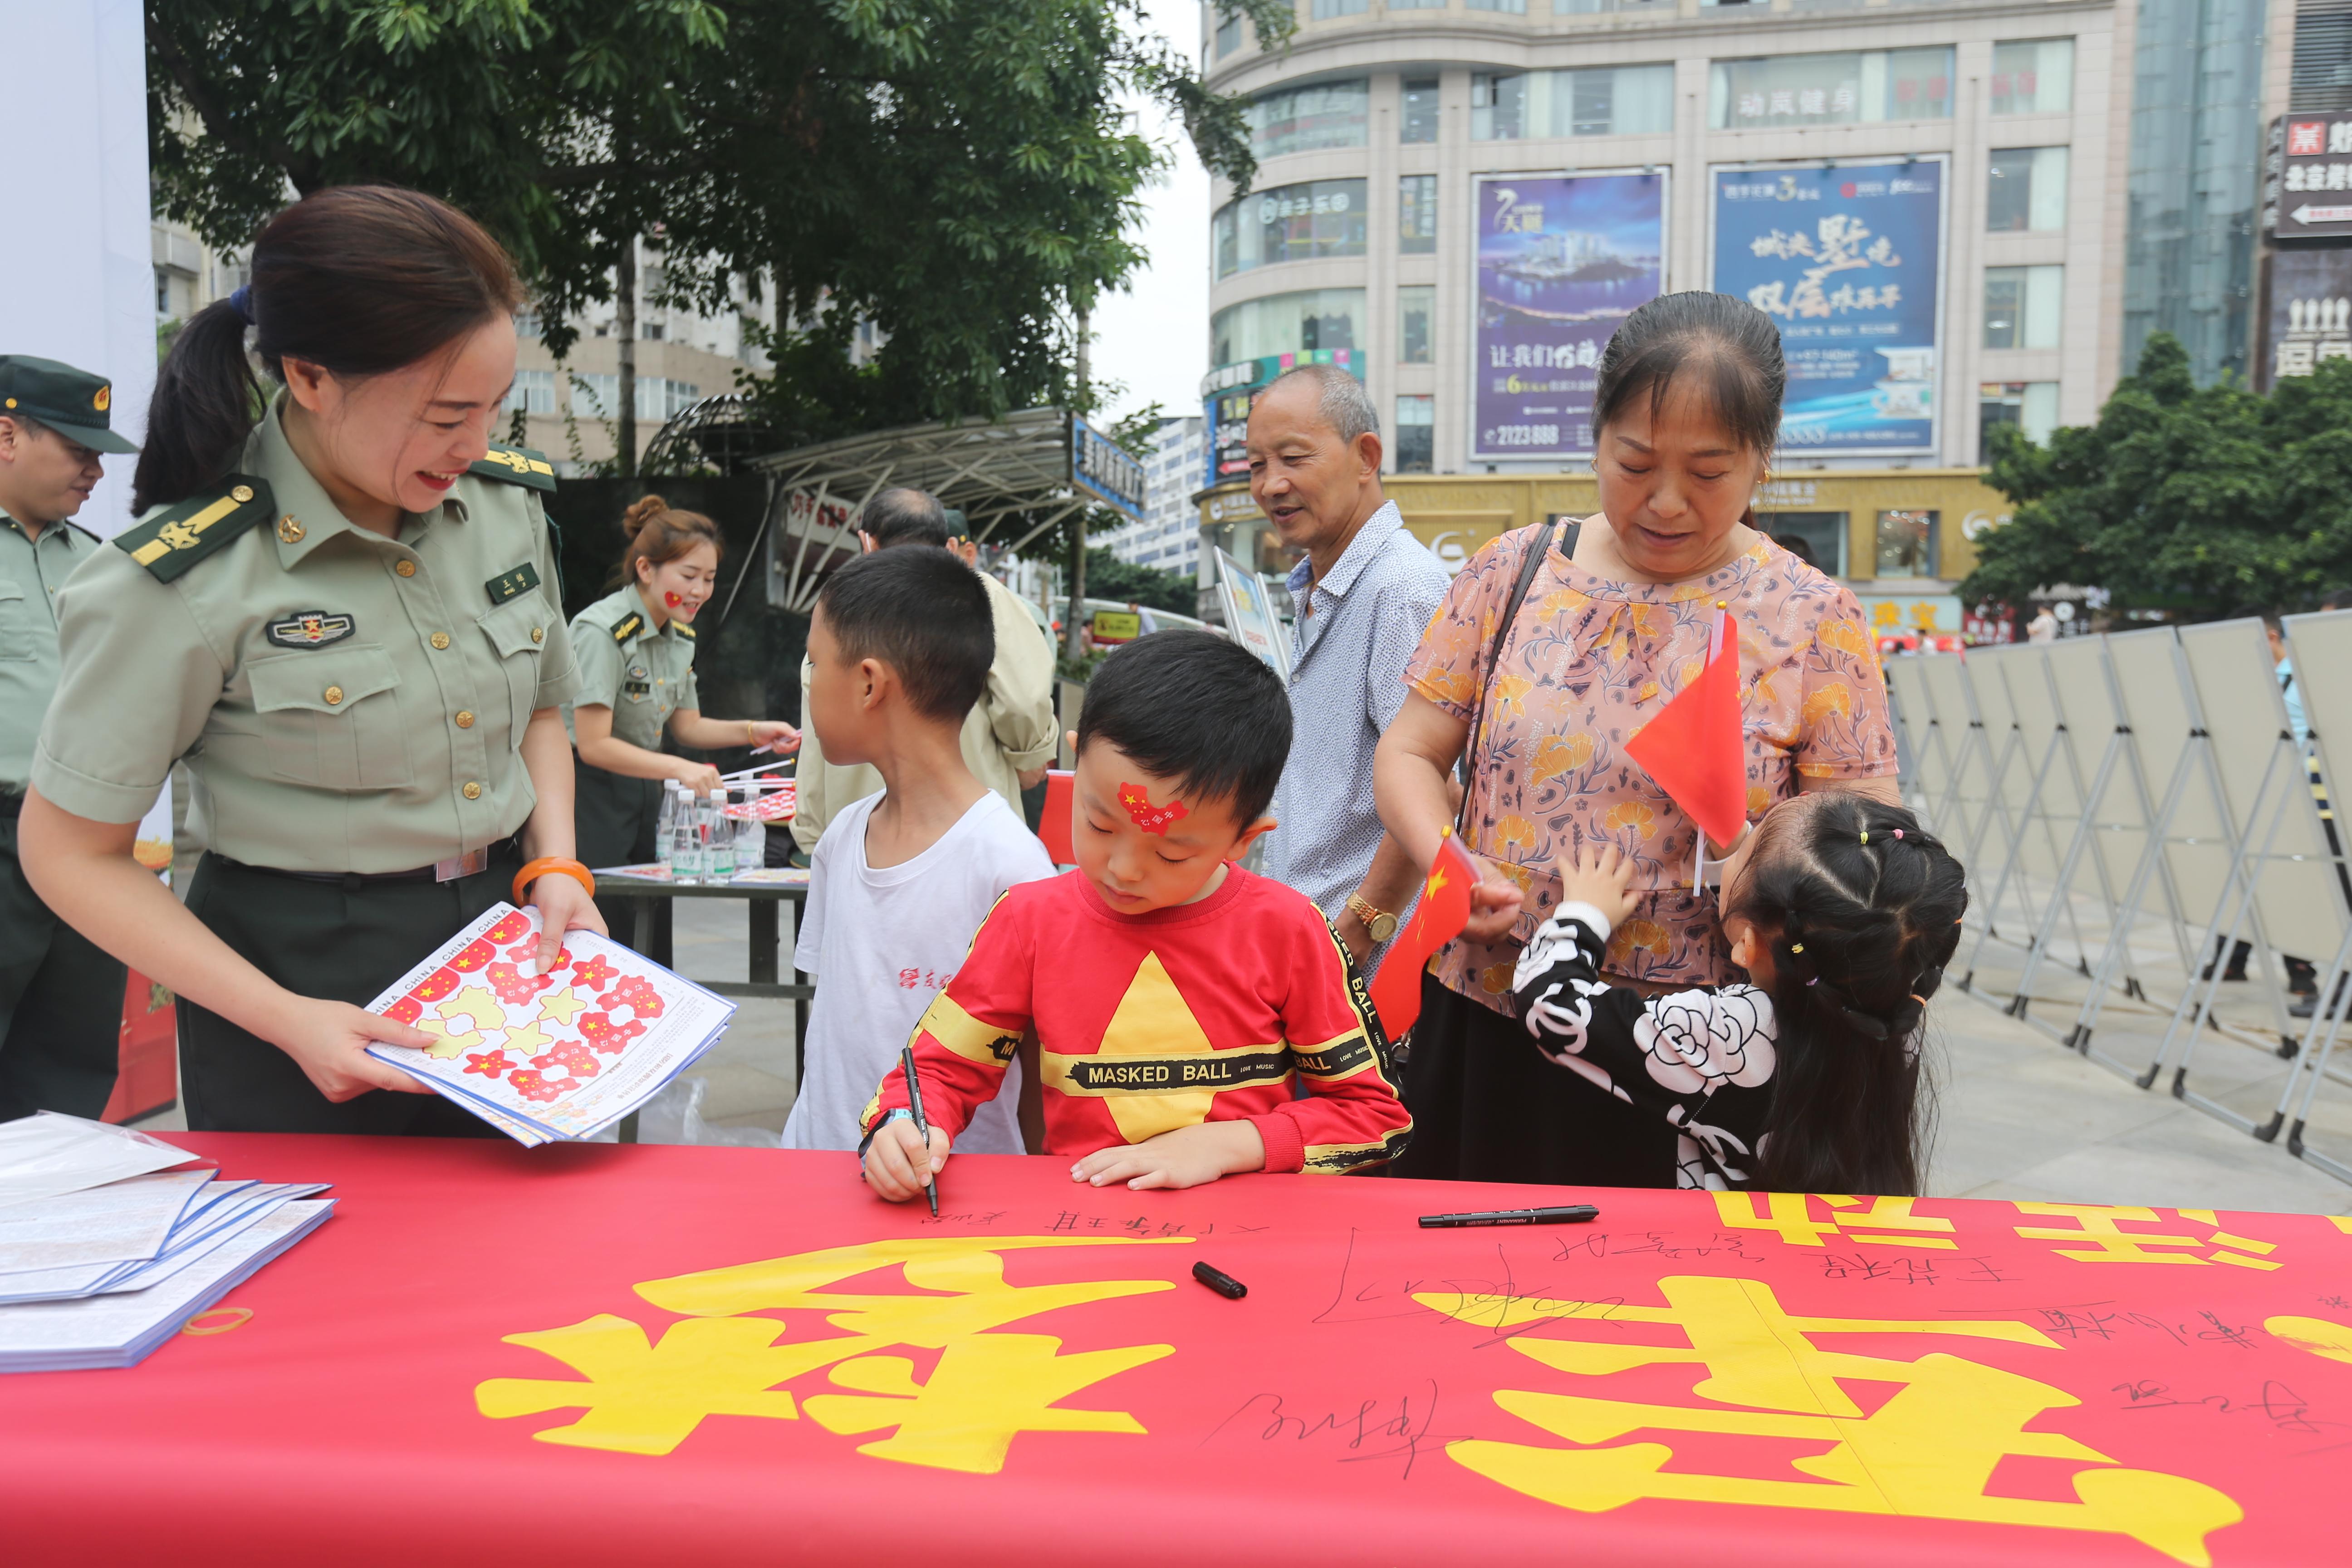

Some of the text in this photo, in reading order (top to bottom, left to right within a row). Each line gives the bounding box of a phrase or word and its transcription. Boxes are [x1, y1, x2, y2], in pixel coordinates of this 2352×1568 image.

[1497, 424, 1559, 446] 2123888
[1141, 811, 1173, 826] 中国心
[478, 908, 509, 933] CHINA
[442, 936, 475, 961] CHINA
[405, 965, 438, 990] CHINA
[374, 994, 400, 1015] HINA
[1352, 976, 1377, 1024] BALL
[1374, 1031, 1382, 1047] LOVE
[1294, 1054, 1332, 1070] BALL
[1339, 1052, 1352, 1063] LOVE
[1089, 1066, 1170, 1084] MASKED
[1183, 1063, 1232, 1082] BALL
